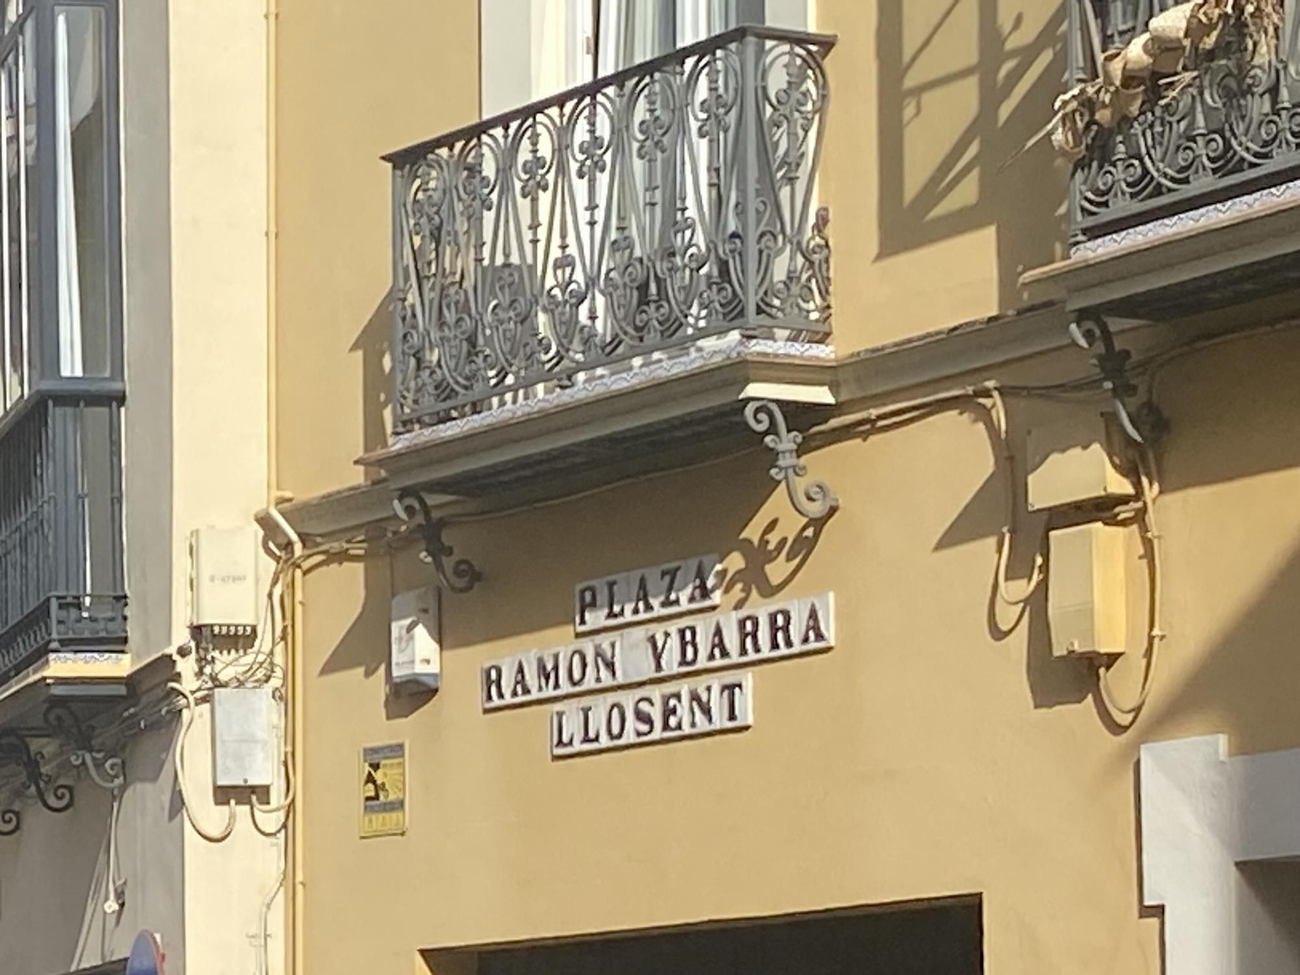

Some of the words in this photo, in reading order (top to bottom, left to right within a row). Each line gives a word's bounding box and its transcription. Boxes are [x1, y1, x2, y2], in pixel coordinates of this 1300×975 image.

[577, 559, 713, 627] PLAZA
[483, 640, 618, 703] RAMON
[647, 601, 828, 674] YBARRA
[554, 682, 743, 749] LLOSENT
